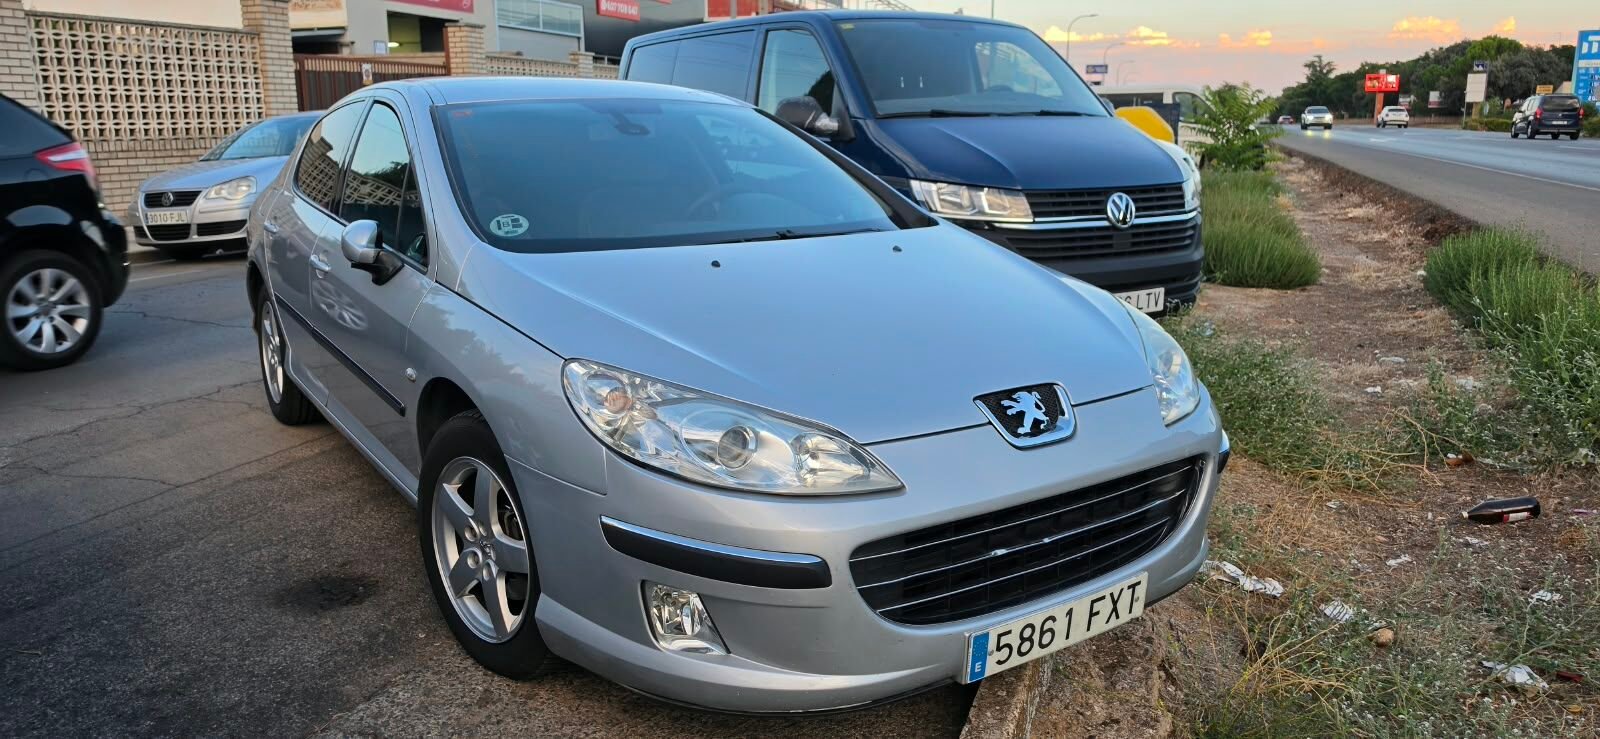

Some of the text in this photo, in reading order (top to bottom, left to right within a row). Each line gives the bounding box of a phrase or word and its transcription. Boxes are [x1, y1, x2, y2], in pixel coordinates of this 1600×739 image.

[149, 213, 168, 223] 3010
[1136, 291, 1161, 310] LTV
[995, 580, 1142, 665] 5861 FXT
[974, 661, 982, 672] E
